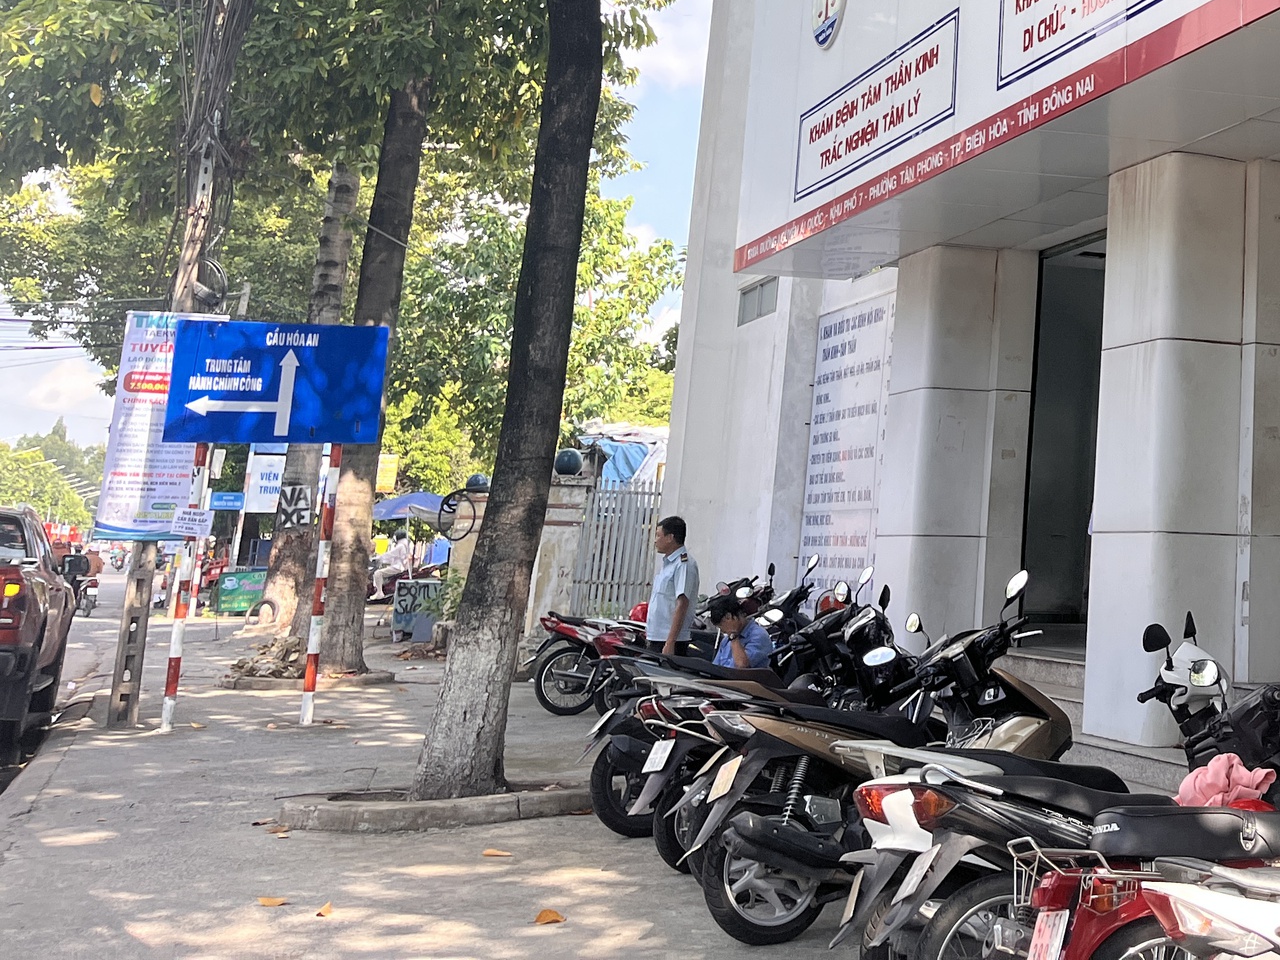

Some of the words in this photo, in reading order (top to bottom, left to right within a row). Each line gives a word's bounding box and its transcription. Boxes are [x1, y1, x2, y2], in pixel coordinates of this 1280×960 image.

[1023, 25, 1034, 53] DI
[809, 113, 834, 145] KHÁM
[861, 82, 882, 112] TÂM
[885, 59, 912, 96] THẦN
[914, 44, 940, 78] KINH
[882, 103, 905, 133] TÂM
[907, 88, 922, 118] LÝ
[900, 167, 915, 186] TÂN
[916, 151, 944, 178] PHONG
[965, 129, 985, 153] BIÊN
[988, 117, 1008, 141] HÒA
[1042, 89, 1073, 116] ĐỒNG
[1075, 73, 1095, 100] NAI
[266, 327, 286, 346] CẦU
[286, 330, 305, 346] HÓA
[306, 333, 319, 347] AN
[205, 359, 233, 373] TRUNG
[233, 356, 251, 373] TÂM
[188, 373, 213, 391] HÀNH
[213, 374, 240, 391] CHÍNH
[239, 375, 262, 392] CÔNG
[260, 472, 279, 484] VIỆN
